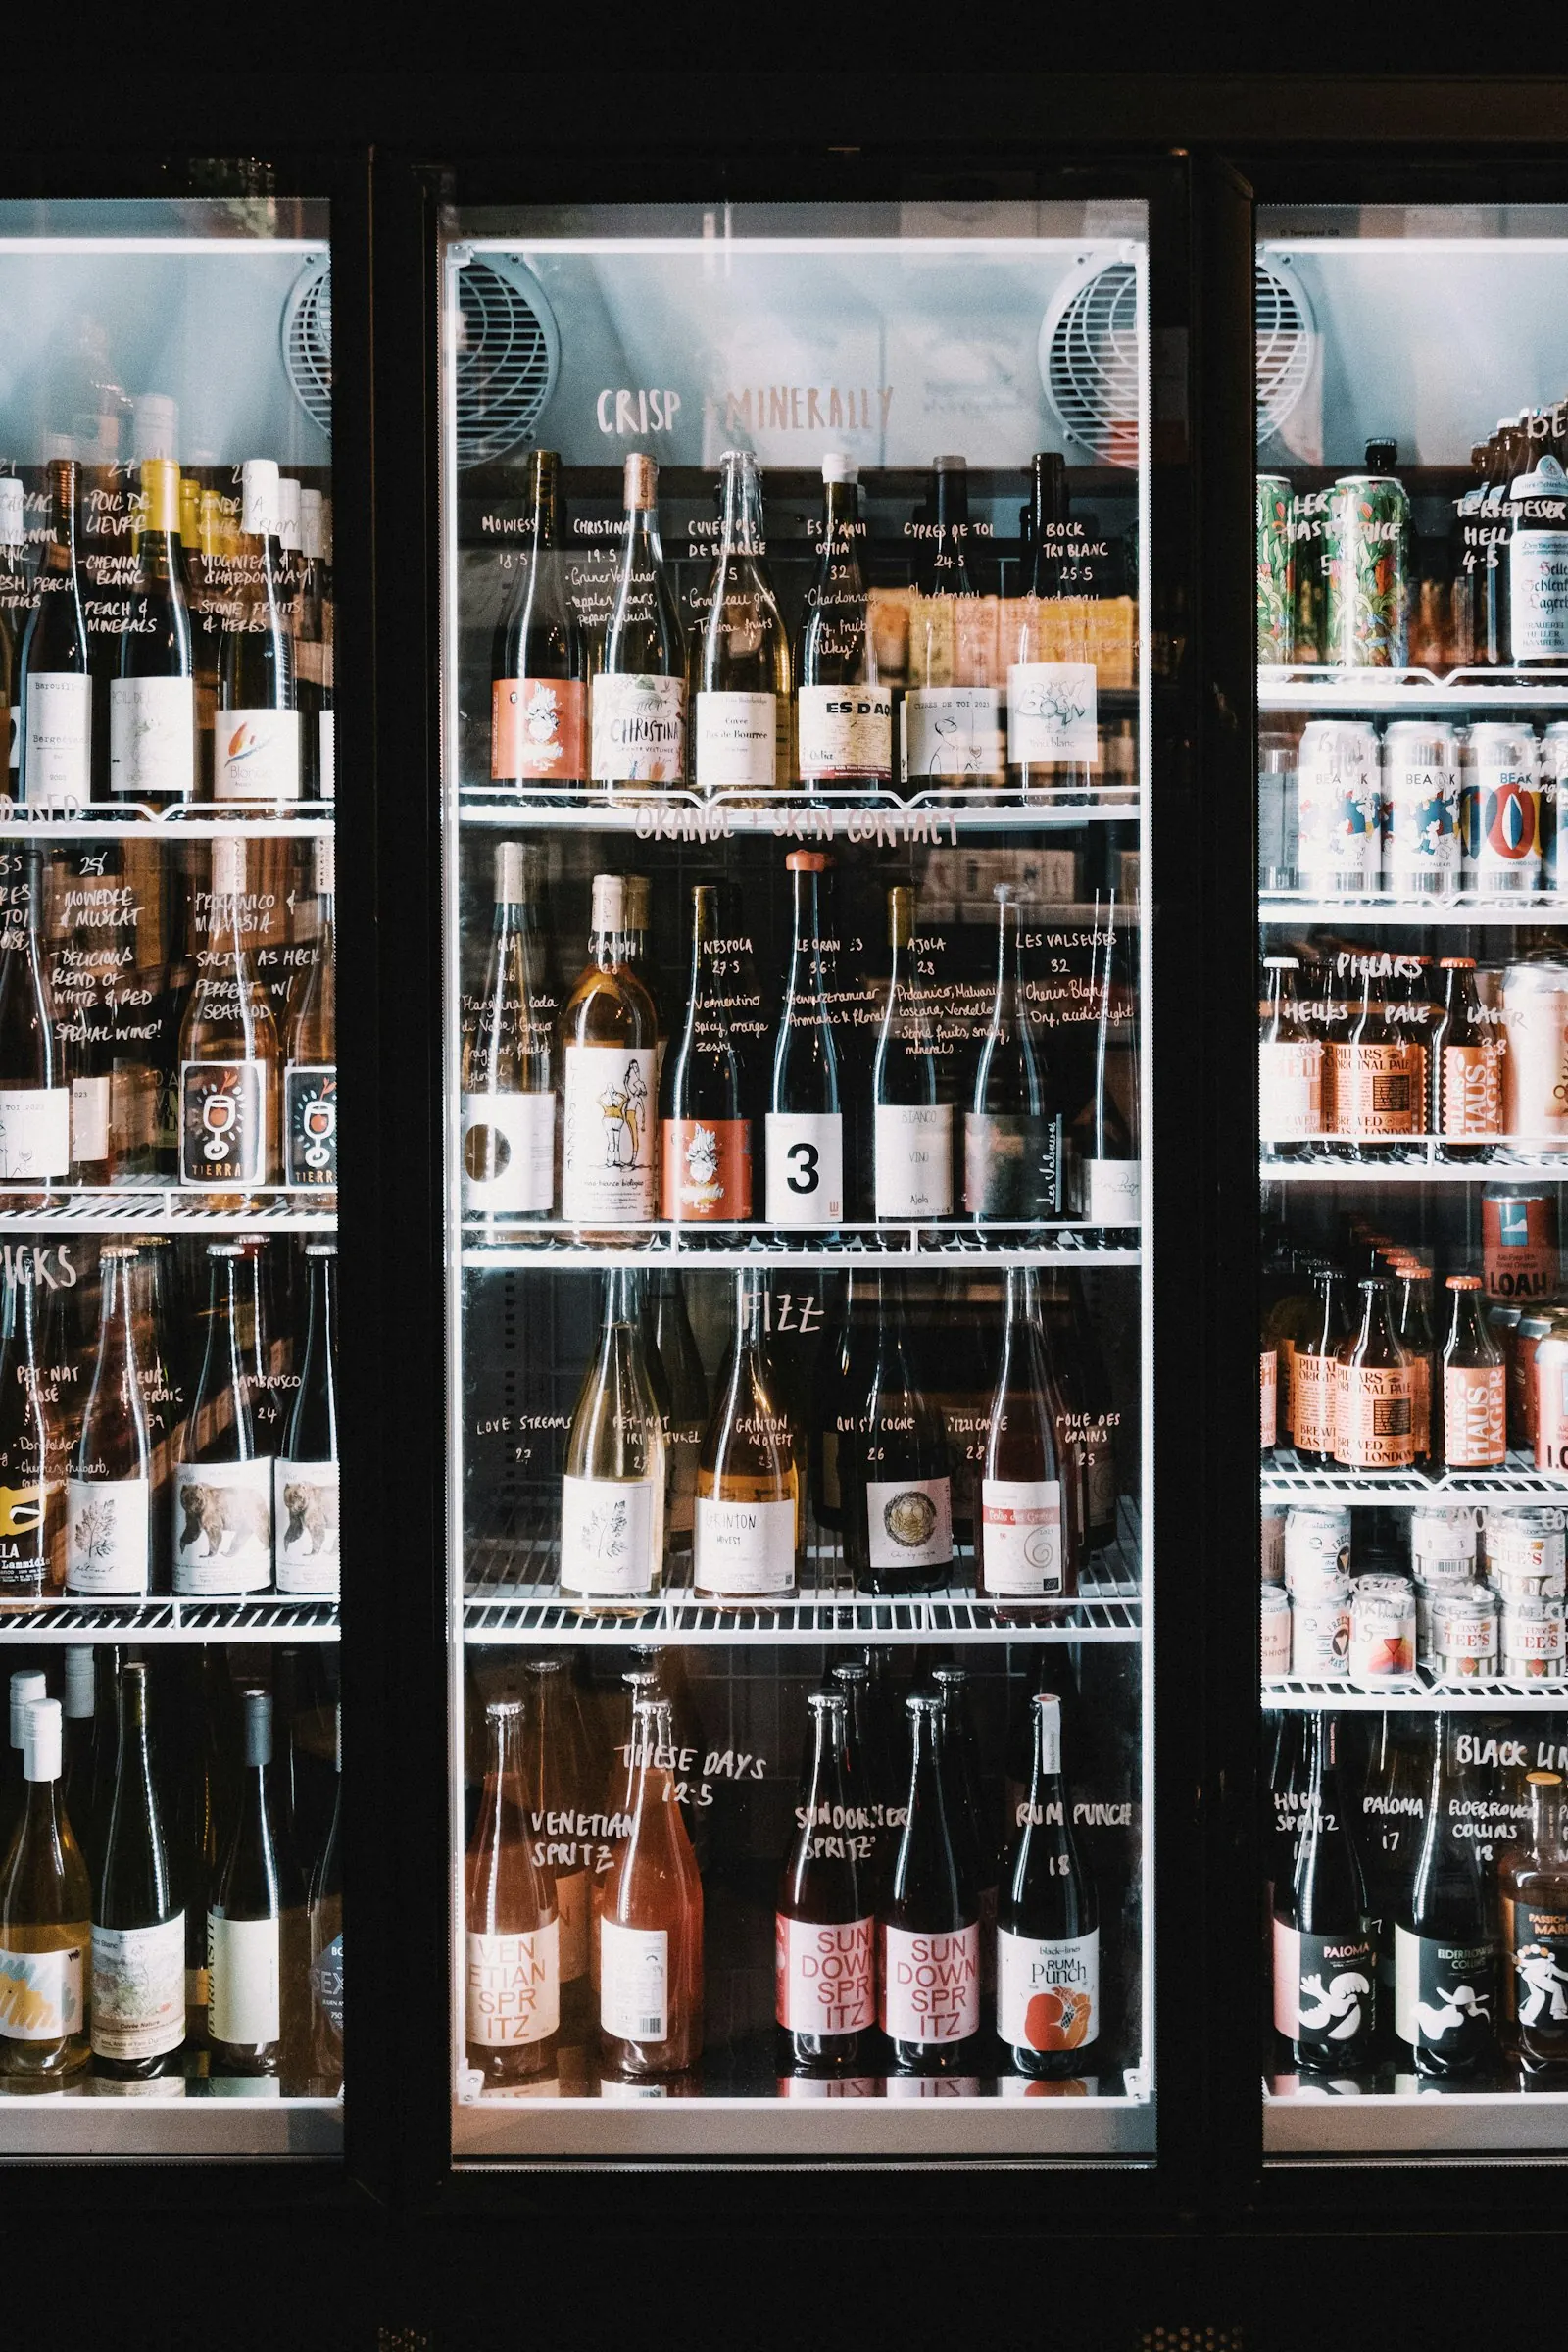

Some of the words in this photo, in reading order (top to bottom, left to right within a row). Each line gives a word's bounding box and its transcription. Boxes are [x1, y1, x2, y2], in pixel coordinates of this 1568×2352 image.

[596, 389, 682, 434] CRISP
[725, 385, 894, 431] MINERALLY
[573, 519, 633, 534] CHRISTINA
[807, 522, 822, 536] ES
[951, 523, 966, 538] DE
[973, 522, 994, 537] TOI
[1046, 522, 1085, 537] BOCK
[689, 543, 708, 557] DE
[1067, 541, 1109, 557] BLANC
[85, 555, 140, 570] CHENIN
[934, 554, 965, 568] 24.5
[97, 568, 147, 585] BLANC
[830, 566, 850, 580] 32
[33, 576, 74, 592] PEACH
[85, 600, 131, 616] PEACH
[199, 599, 244, 615] STONE
[87, 616, 157, 634] MINERALS
[826, 701, 852, 713] ES
[610, 717, 678, 744] CHRISTINA
[634, 806, 735, 841] ORANGE
[772, 809, 833, 843] SKIN
[848, 809, 959, 848] CONTACT
[76, 906, 146, 927] MUSCAT
[703, 938, 754, 955] NESPOLA
[907, 938, 947, 955] AJOLA
[1016, 934, 1043, 950] LES
[1046, 932, 1118, 947] VALSEUSES
[257, 952, 278, 967] AS
[917, 961, 935, 975] 28
[1050, 958, 1070, 973] 32
[54, 990, 99, 1006] WHITE
[121, 989, 153, 1005] RED
[1025, 982, 1068, 1002] Chenin
[694, 993, 761, 1010] Vermentino
[1384, 1004, 1431, 1024] PALE
[1389, 1060, 1411, 1071] PALE
[900, 1109, 937, 1124] BIANCO
[191, 1162, 242, 1177] TIERRA
[786, 1142, 820, 1196] 3
[0, 1245, 77, 1290] ICKS
[1490, 1272, 1547, 1296] LOAH
[740, 1290, 825, 1334] FIZZ
[1390, 1382, 1412, 1395] PALE
[257, 1406, 277, 1424] 24
[735, 1414, 787, 1434] GRINTON
[1098, 1413, 1121, 1427] DES
[477, 1418, 510, 1436] LOVE
[519, 1415, 572, 1431] STREAMS
[880, 1417, 915, 1432] COGNE
[866, 1446, 885, 1461] 26
[965, 1445, 984, 1461] 28
[1456, 1734, 1528, 1768] BLACK
[613, 1741, 698, 1772] THESE
[703, 1749, 767, 1781] DAYS
[662, 1782, 714, 1806] 12.5
[1015, 1802, 1064, 1828] RUM
[1073, 1802, 1132, 1827] PUNCH
[1362, 1796, 1424, 1819] PALOMA
[531, 1809, 637, 1838] VENETIAN
[1451, 1823, 1518, 1840] COLLINS
[531, 1842, 615, 1874] SPRITZ
[1474, 1844, 1494, 1862] 18
[1049, 1854, 1070, 1877] 18
[817, 1924, 872, 1955] SUN
[911, 1935, 966, 1963] SUN
[1323, 1942, 1371, 1959] PALOMA
[897, 1954, 978, 1989] DOWN
[1032, 1962, 1088, 1984] Punch
[1047, 1958, 1076, 1971] RUM
[468, 1959, 546, 1989] ETIAN
[817, 1975, 870, 2005] SPR
[911, 1985, 967, 2013] SPR
[478, 1988, 538, 2015] SPR
[826, 2003, 865, 2030] ITZ
[920, 2012, 961, 2038] ITZ
[487, 2015, 530, 2040] ITZ
